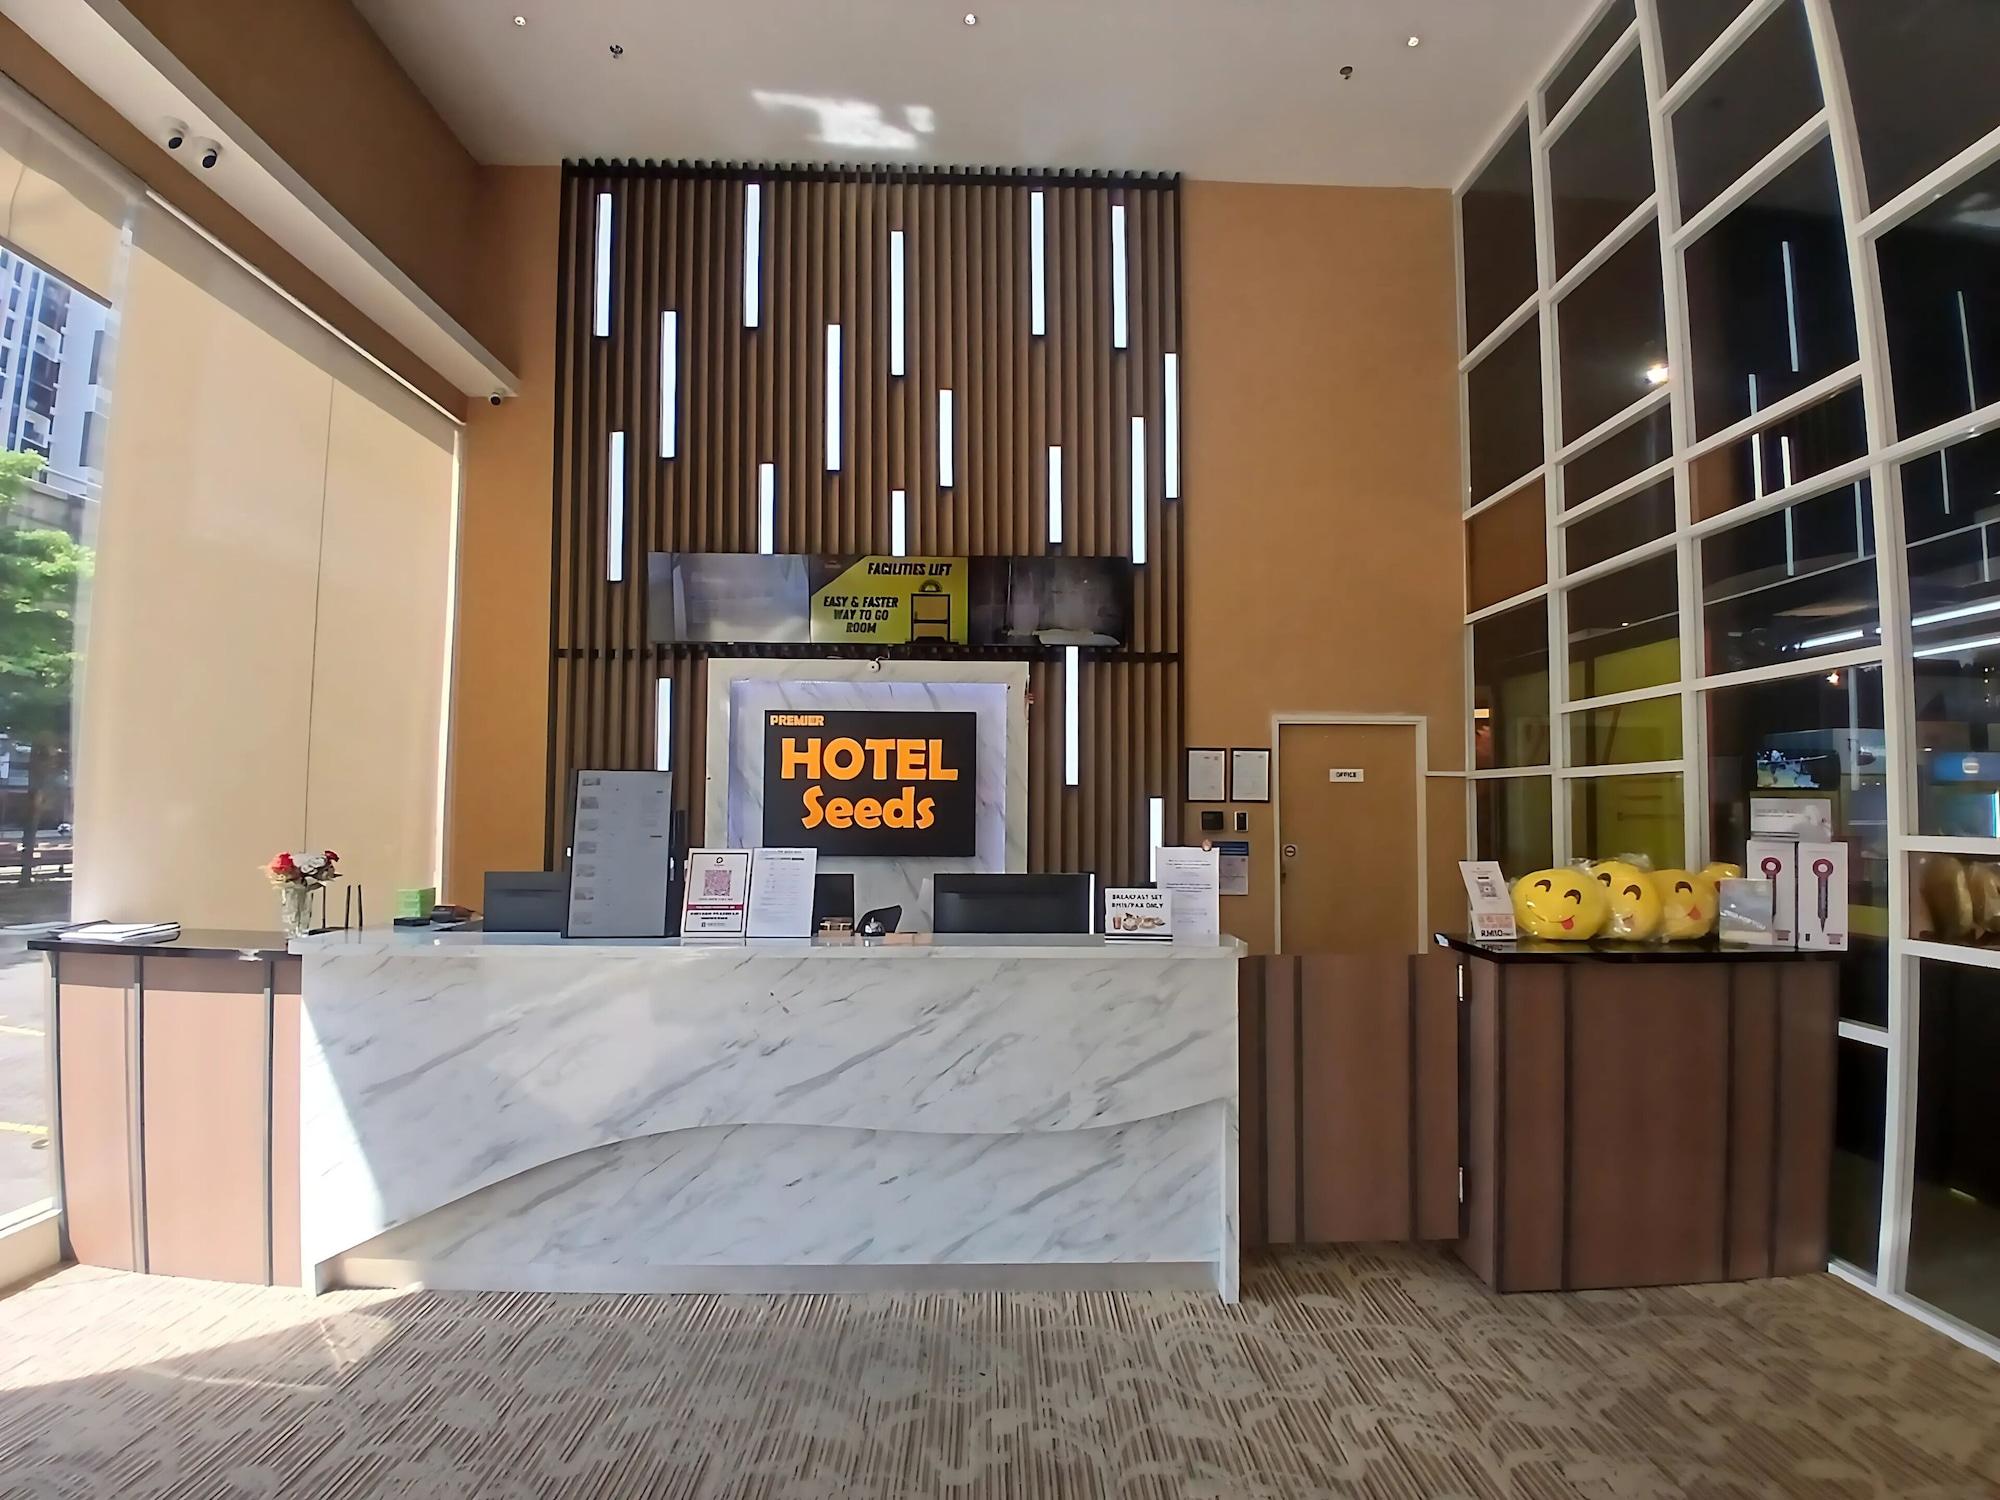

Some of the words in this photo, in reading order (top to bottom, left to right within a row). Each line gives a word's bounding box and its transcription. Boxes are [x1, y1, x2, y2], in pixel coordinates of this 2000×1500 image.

[867, 562, 926, 576] FACILITIES
[928, 563, 952, 577] LIFT
[823, 596, 849, 608] EASY
[850, 596, 859, 608] &
[862, 596, 899, 608] FASTER
[833, 609, 856, 620] WAY
[859, 609, 872, 621] TO
[875, 610, 889, 621] GO
[846, 622, 877, 634] ROOM
[769, 714, 825, 727] PREMIER
[781, 737, 959, 781] HOTEL
[801, 785, 936, 830] Seeds
